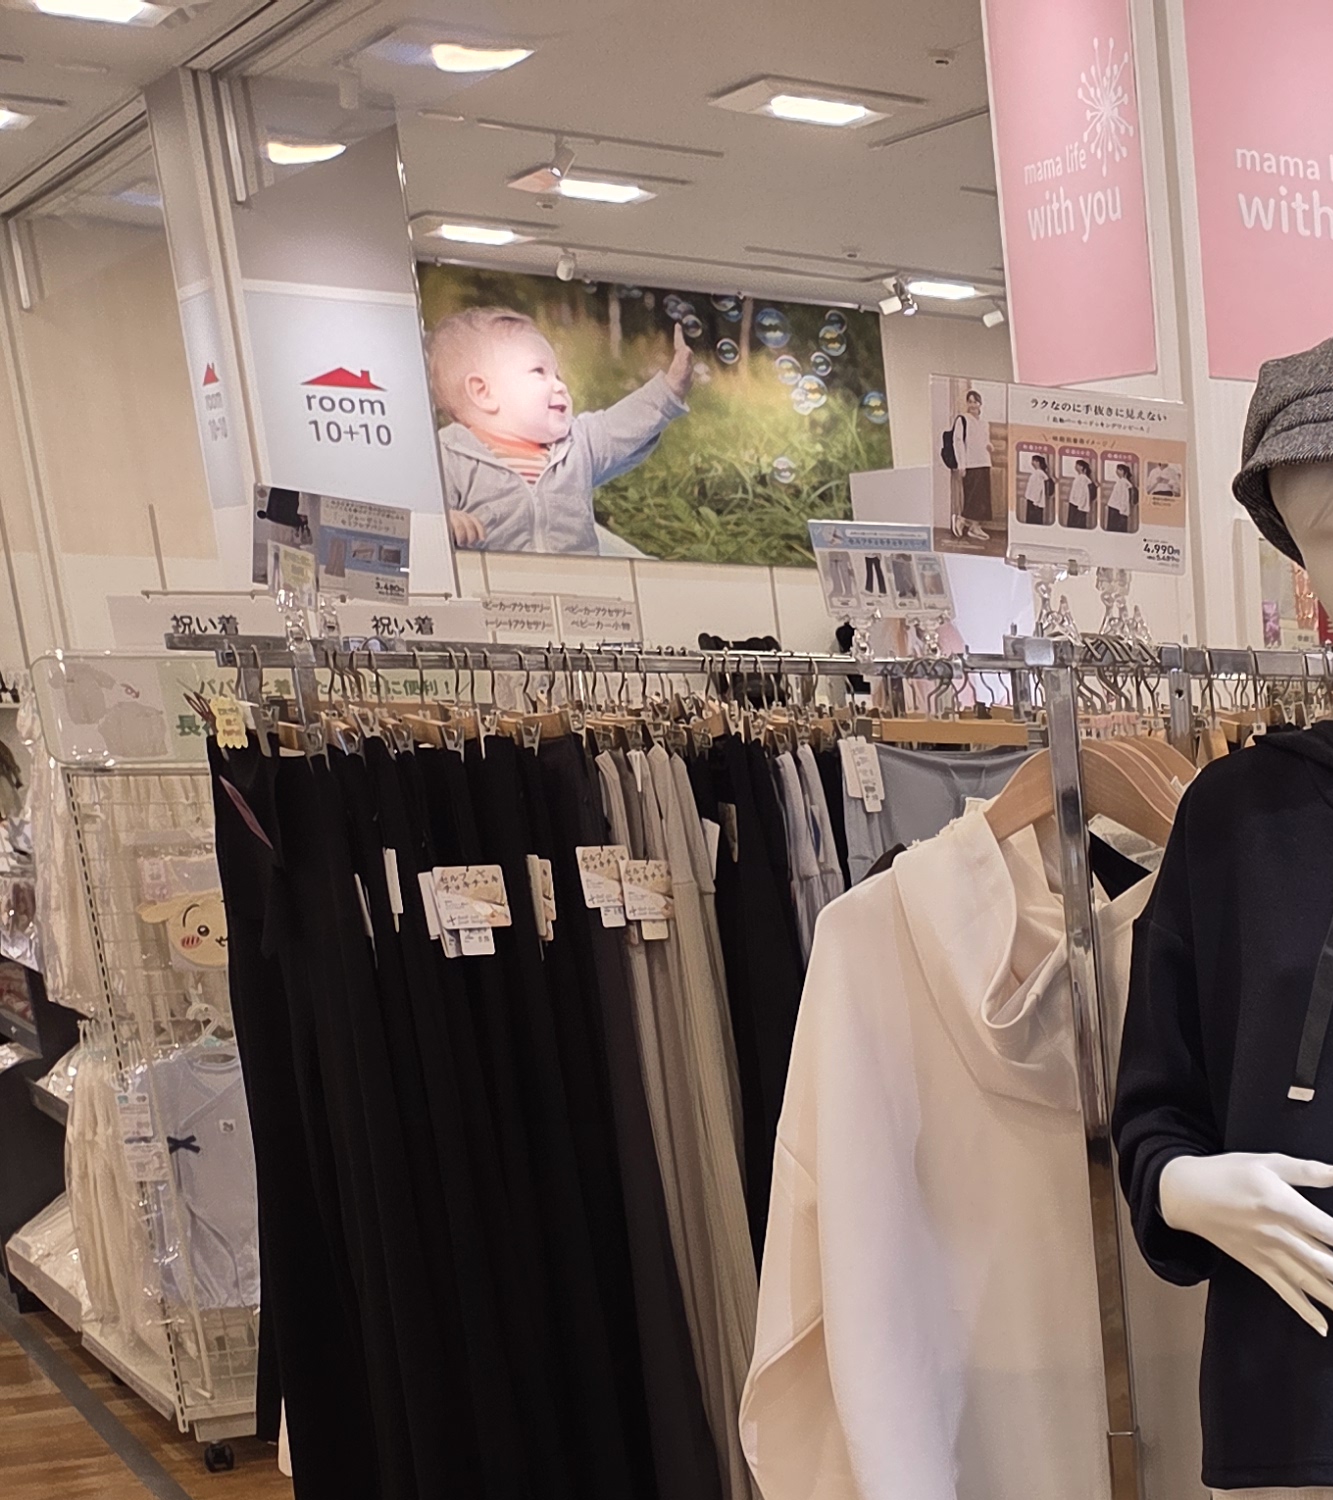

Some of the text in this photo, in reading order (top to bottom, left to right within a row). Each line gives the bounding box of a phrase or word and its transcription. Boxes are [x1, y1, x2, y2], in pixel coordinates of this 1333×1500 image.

[1024, 142, 1086, 185] mama life
[1235, 147, 1320, 182] mama
[1027, 185, 1122, 243] with you
[306, 394, 386, 416] room
[1030, 398, 1168, 422] ラクなのに手抜きに見えない
[308, 419, 392, 446] 10+10
[1143, 543, 1181, 556] 4,990円
[170, 615, 240, 636] 祝い着
[371, 614, 435, 636] 祝い着
